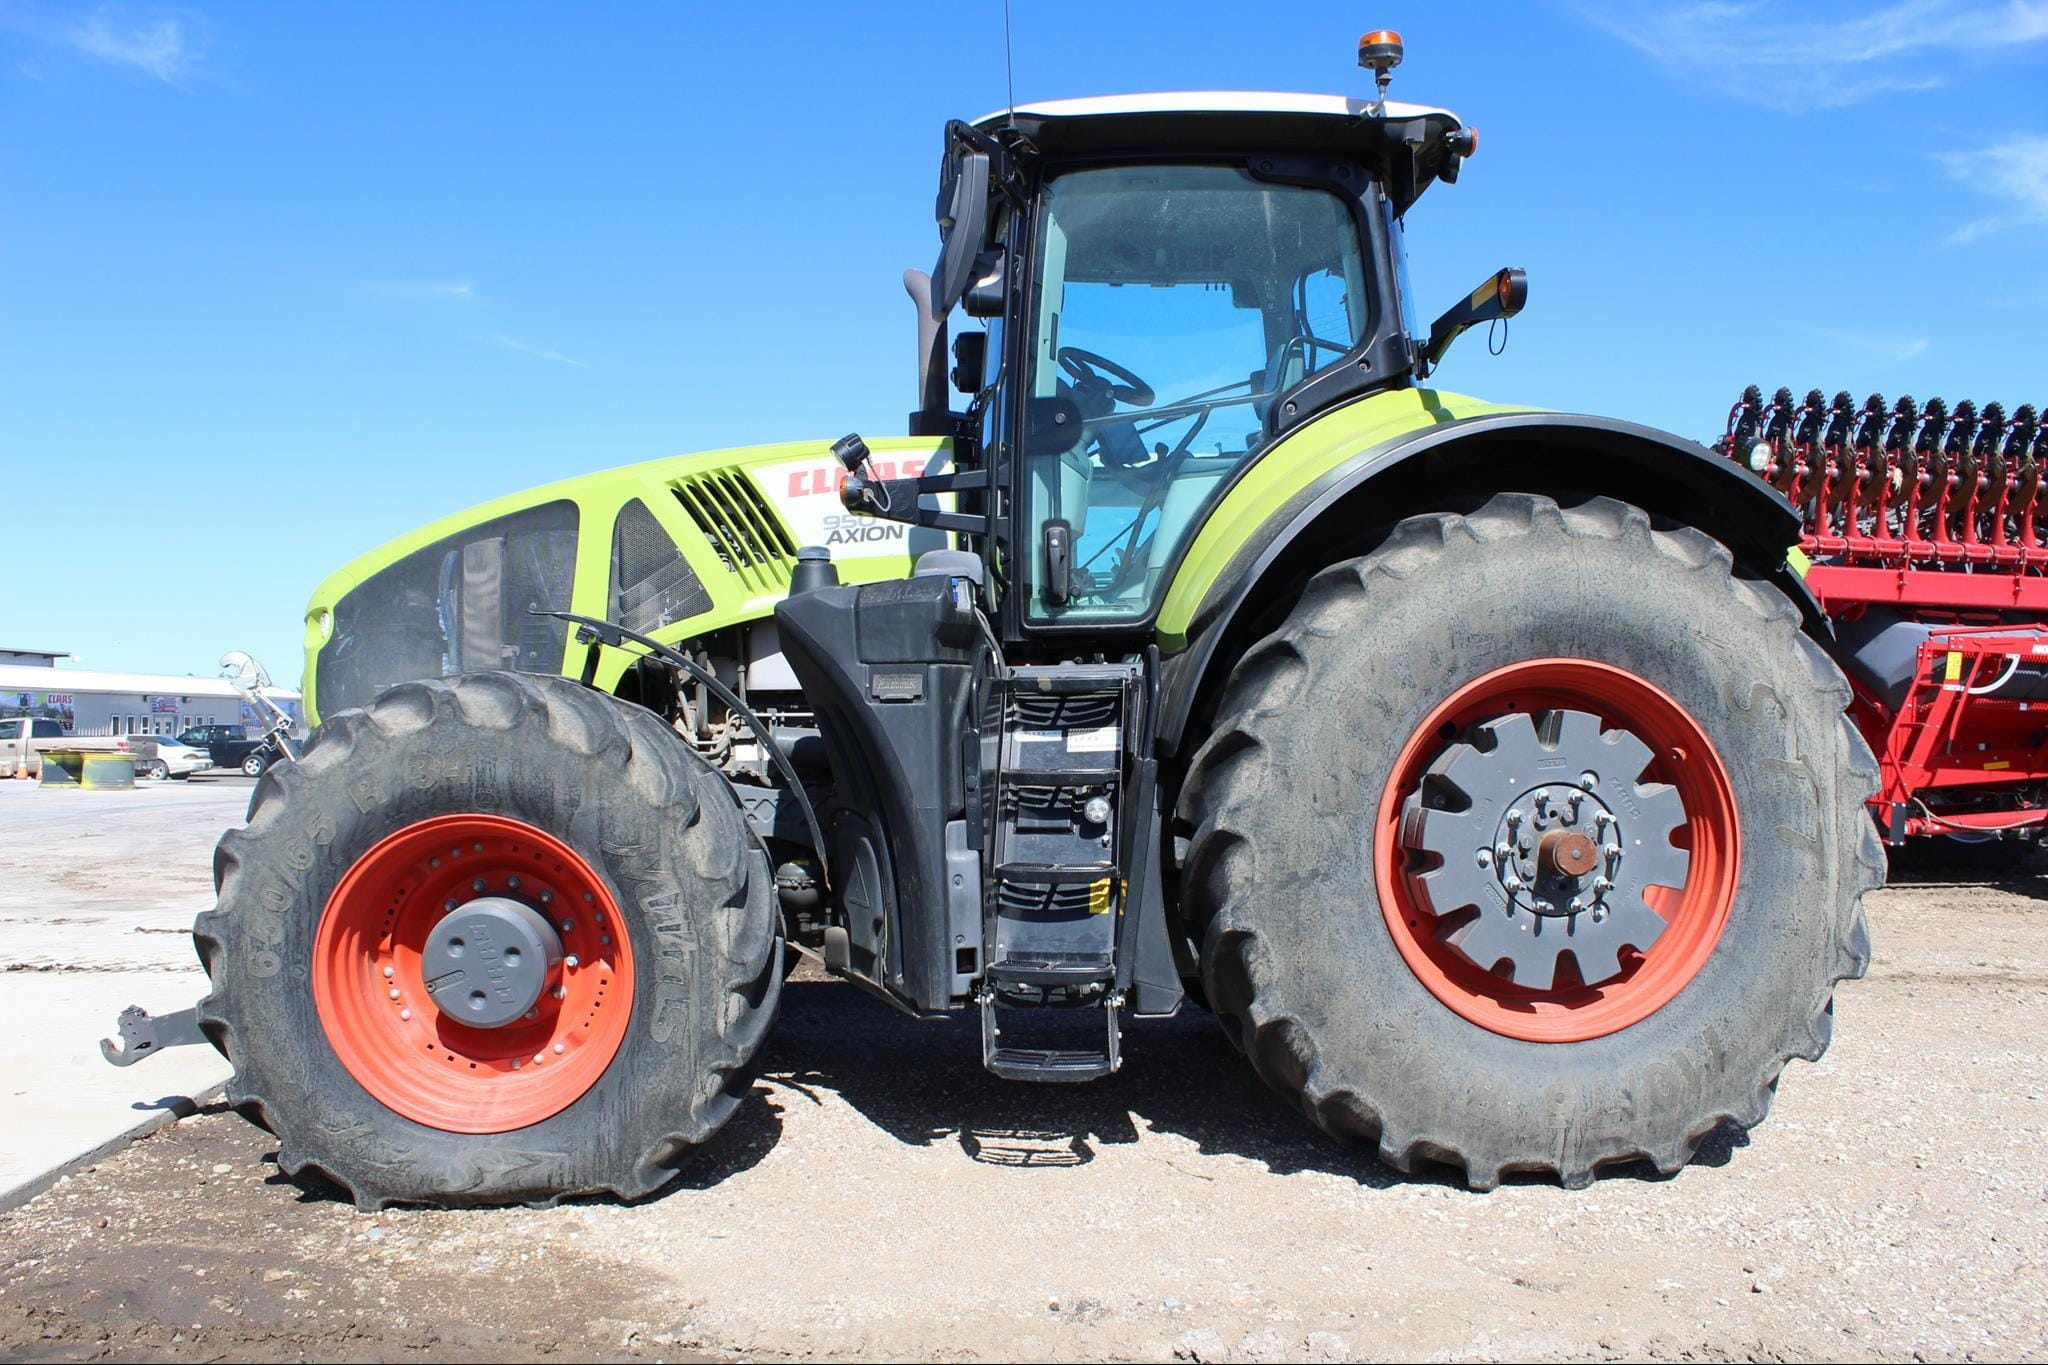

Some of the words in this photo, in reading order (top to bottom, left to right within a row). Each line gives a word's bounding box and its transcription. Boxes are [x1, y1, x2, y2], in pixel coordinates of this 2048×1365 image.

[823, 514, 877, 531] 950
[826, 524, 905, 546] AXION
[47, 694, 73, 704] CLAAS
